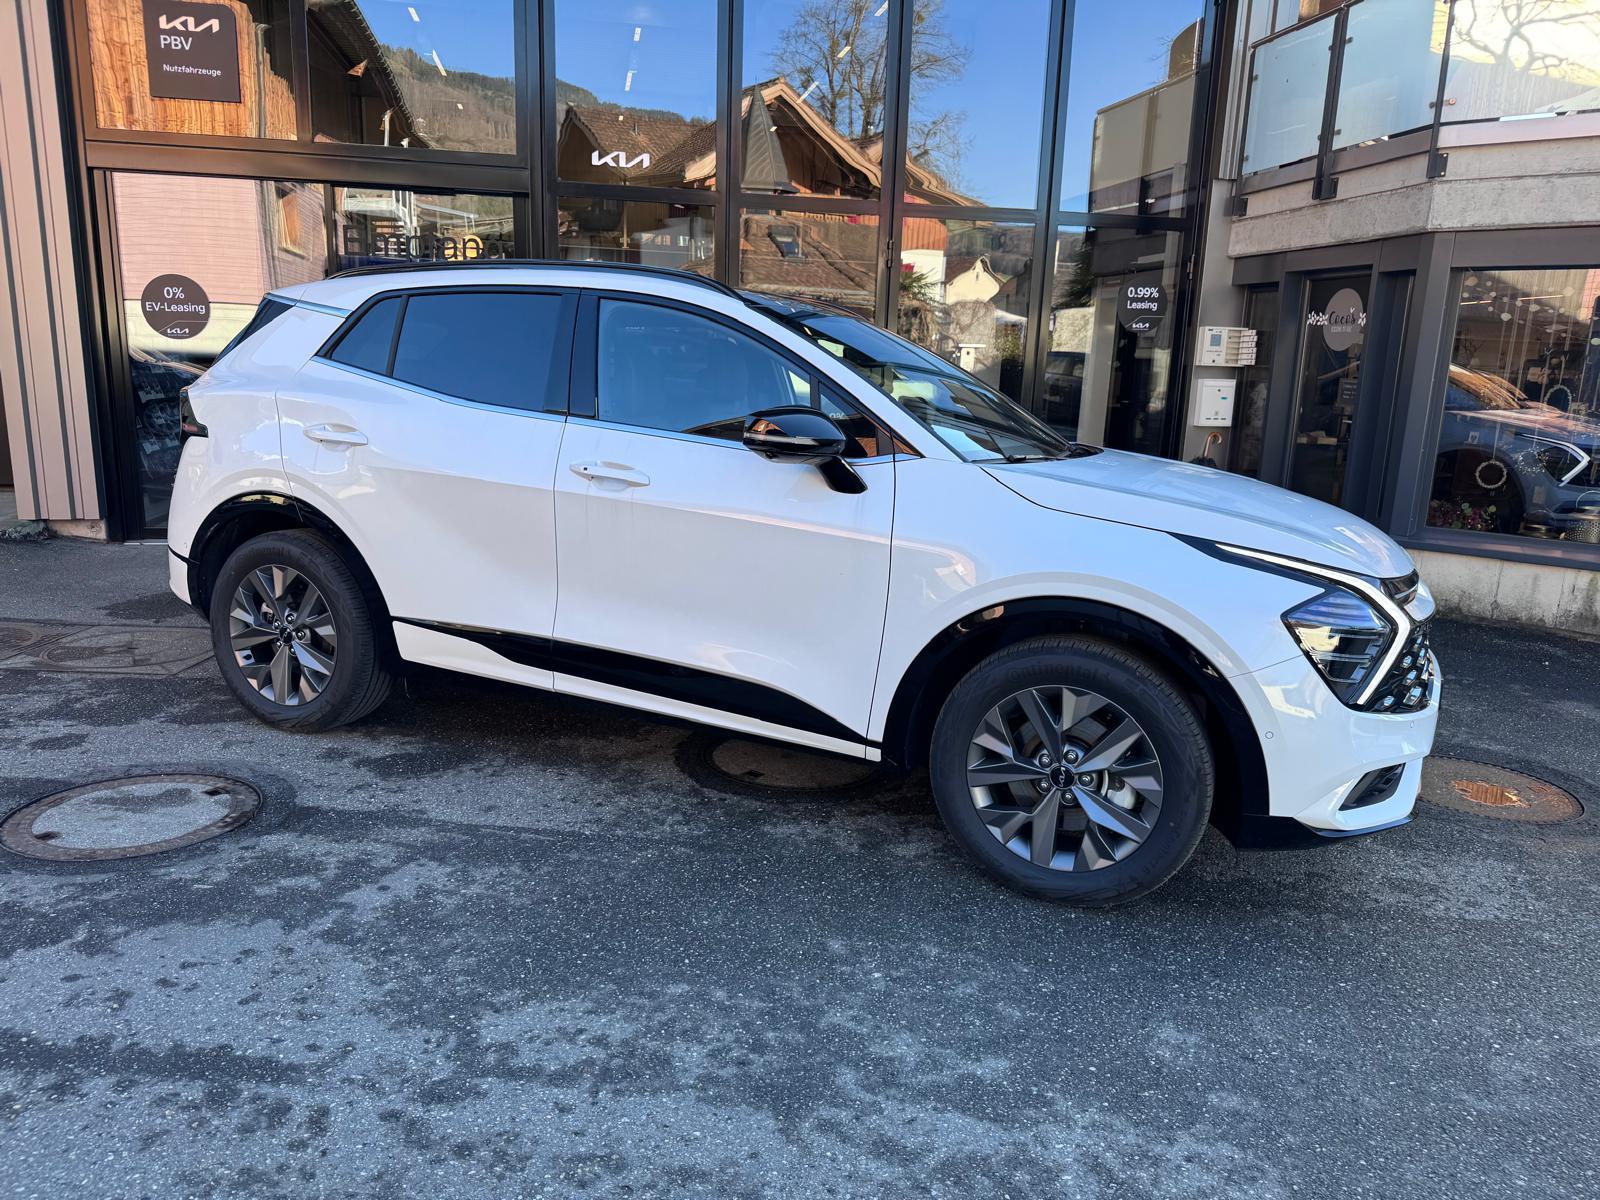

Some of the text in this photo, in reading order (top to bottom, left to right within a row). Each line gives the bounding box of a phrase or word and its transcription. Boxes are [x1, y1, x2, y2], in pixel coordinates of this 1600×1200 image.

[158, 14, 220, 34] KIA
[160, 35, 193, 51] PBV
[162, 63, 222, 77] Nutzfahrzeuge
[591, 150, 650, 169] KIA
[163, 286, 185, 299] 0%
[1127, 286, 1159, 298] 0.99%
[145, 301, 206, 315] EV-Leasing
[1126, 300, 1158, 312] Leasing
